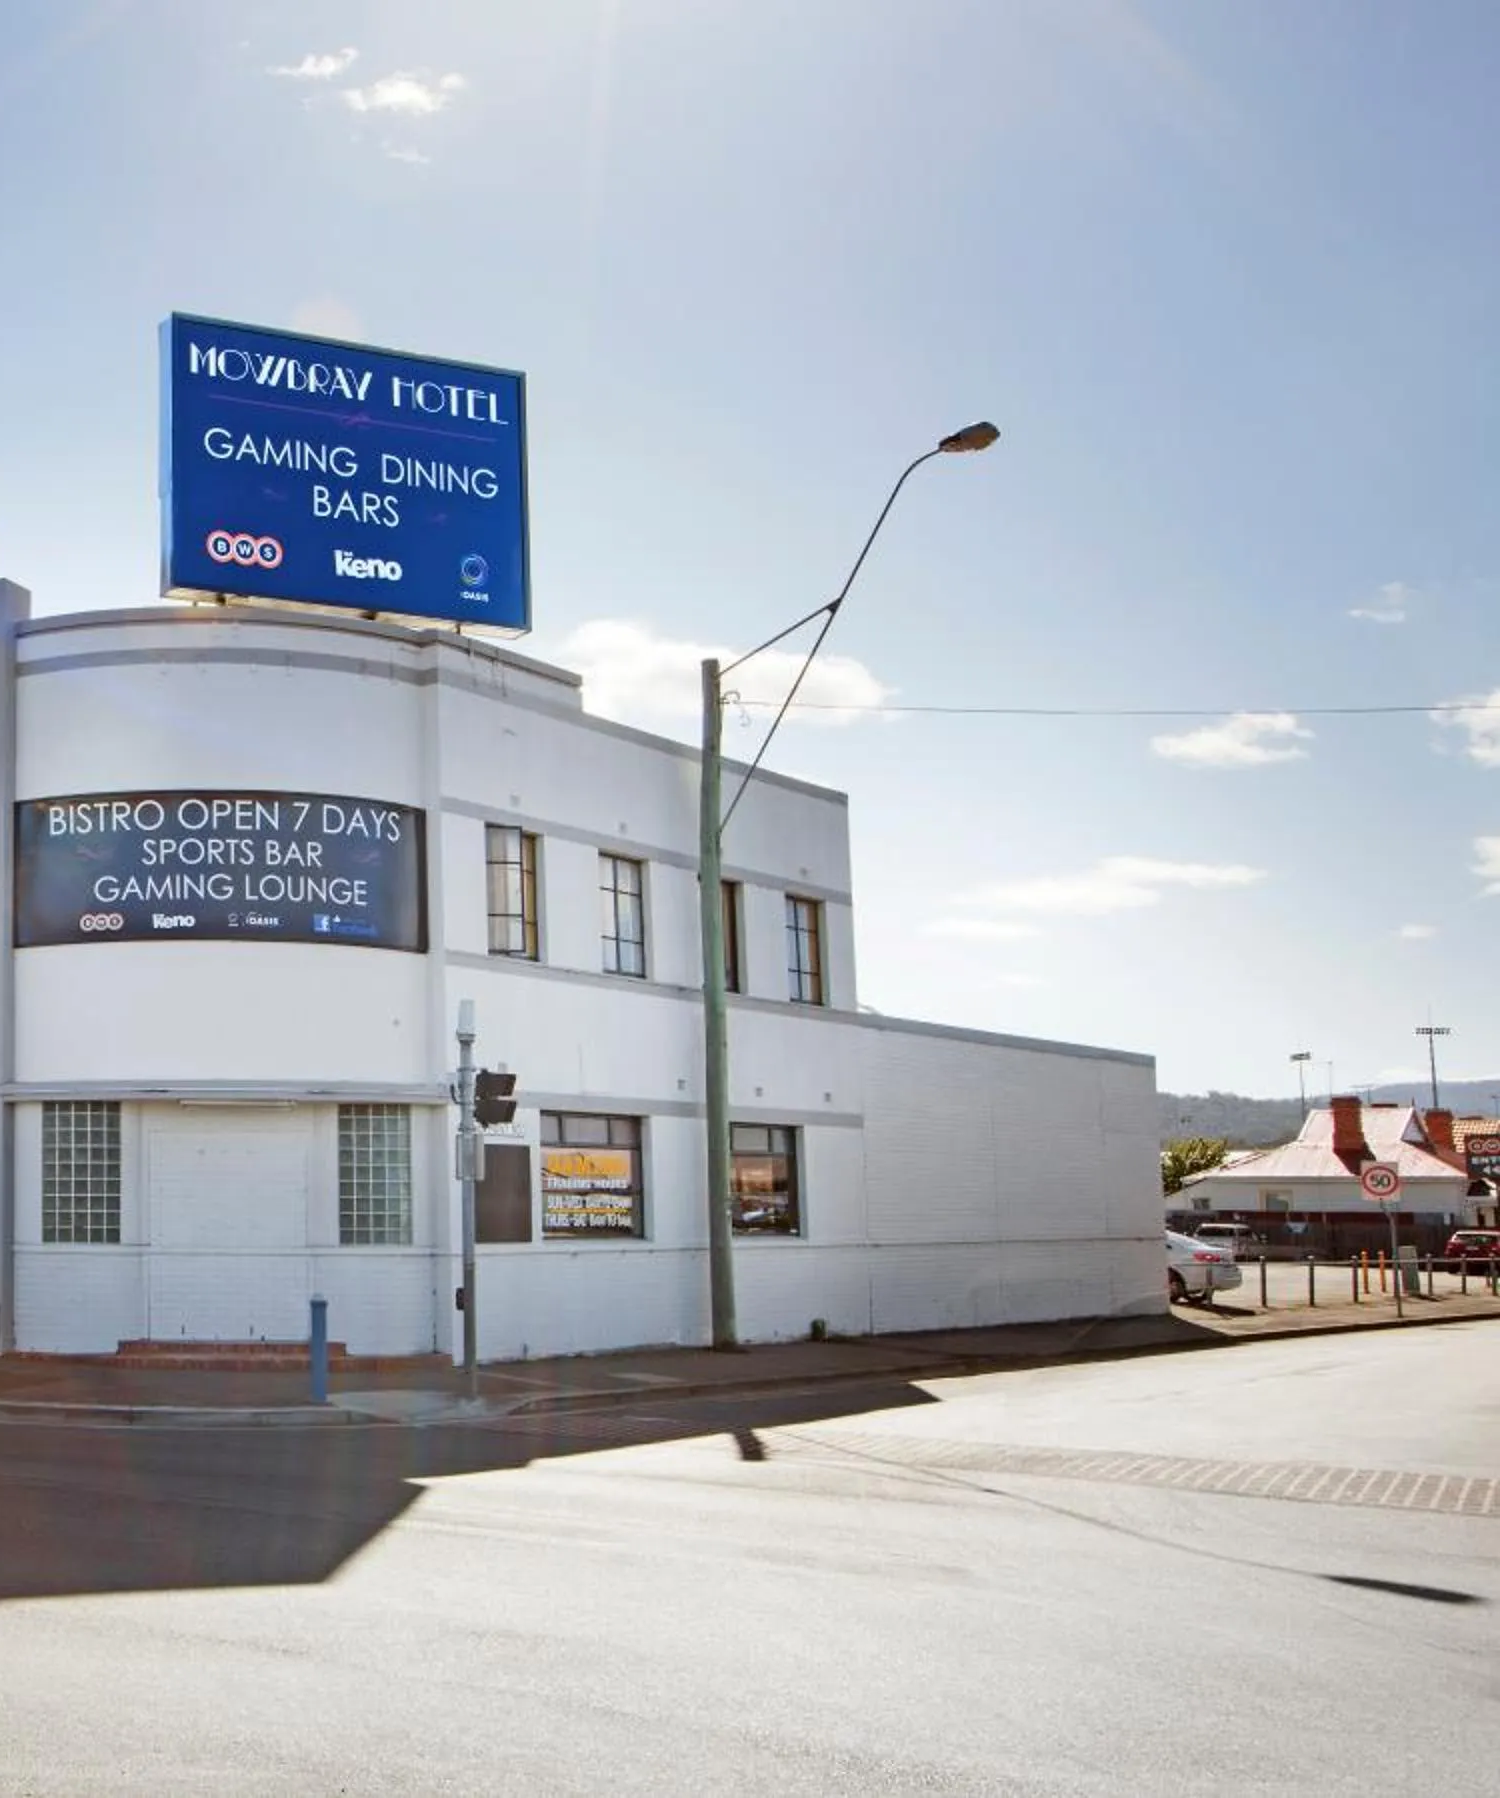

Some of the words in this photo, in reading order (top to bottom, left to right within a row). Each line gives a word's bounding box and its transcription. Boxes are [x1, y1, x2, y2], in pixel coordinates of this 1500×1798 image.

[189, 342, 372, 401] MOWBRAY
[392, 376, 509, 425] HOTEL
[204, 427, 358, 477] GAMING
[381, 453, 498, 499] DINING
[312, 485, 399, 527] BARS
[212, 534, 279, 564] BWS
[49, 799, 163, 836] BISTRO
[177, 799, 279, 831] OPEN
[292, 801, 308, 833] 7
[322, 805, 401, 843] DAYS
[142, 838, 255, 866] SPORTS
[266, 839, 322, 867] BAR
[93, 874, 233, 903] GAMING
[245, 874, 368, 906] LOUNGE
[1370, 1173, 1391, 1188] 50
